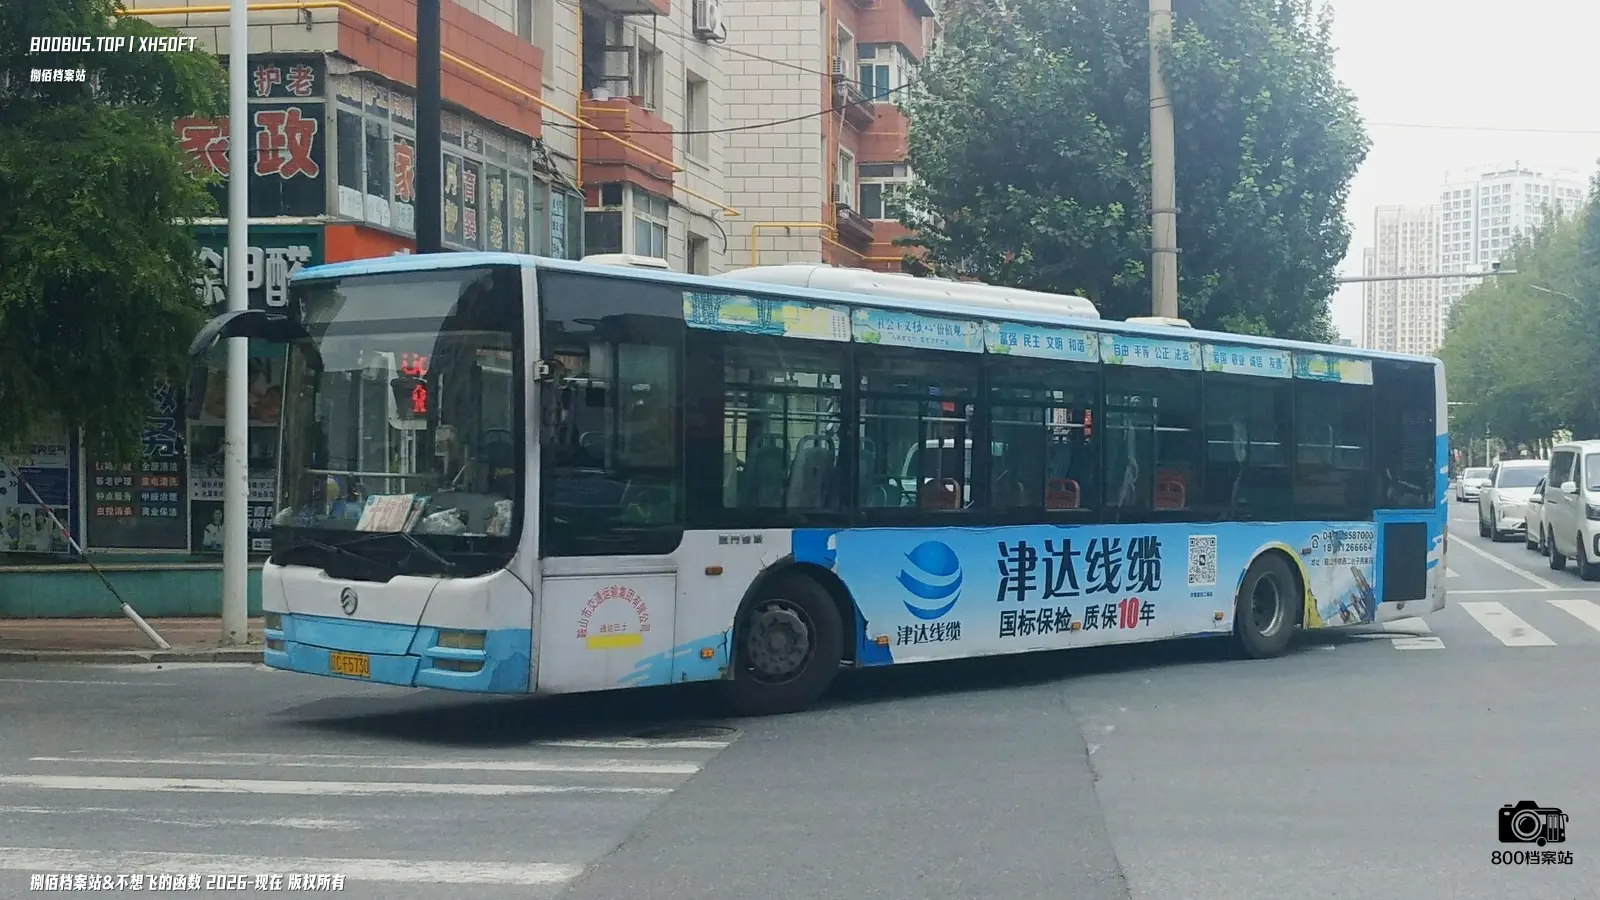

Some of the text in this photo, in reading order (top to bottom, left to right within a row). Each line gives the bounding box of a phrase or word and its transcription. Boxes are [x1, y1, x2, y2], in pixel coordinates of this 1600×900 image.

[254, 64, 315, 97] 护老
[1000, 331, 1085, 353] 富强 民主 文明 和谐
[1114, 343, 1190, 361] 自由 平等 公正 法治
[1213, 352, 1283, 370] 爱国 敬业 诚信 友善
[996, 535, 1162, 602] 津达线缆
[999, 597, 1156, 639] 国标保检 质保10年
[896, 620, 962, 646] 津达线缆
